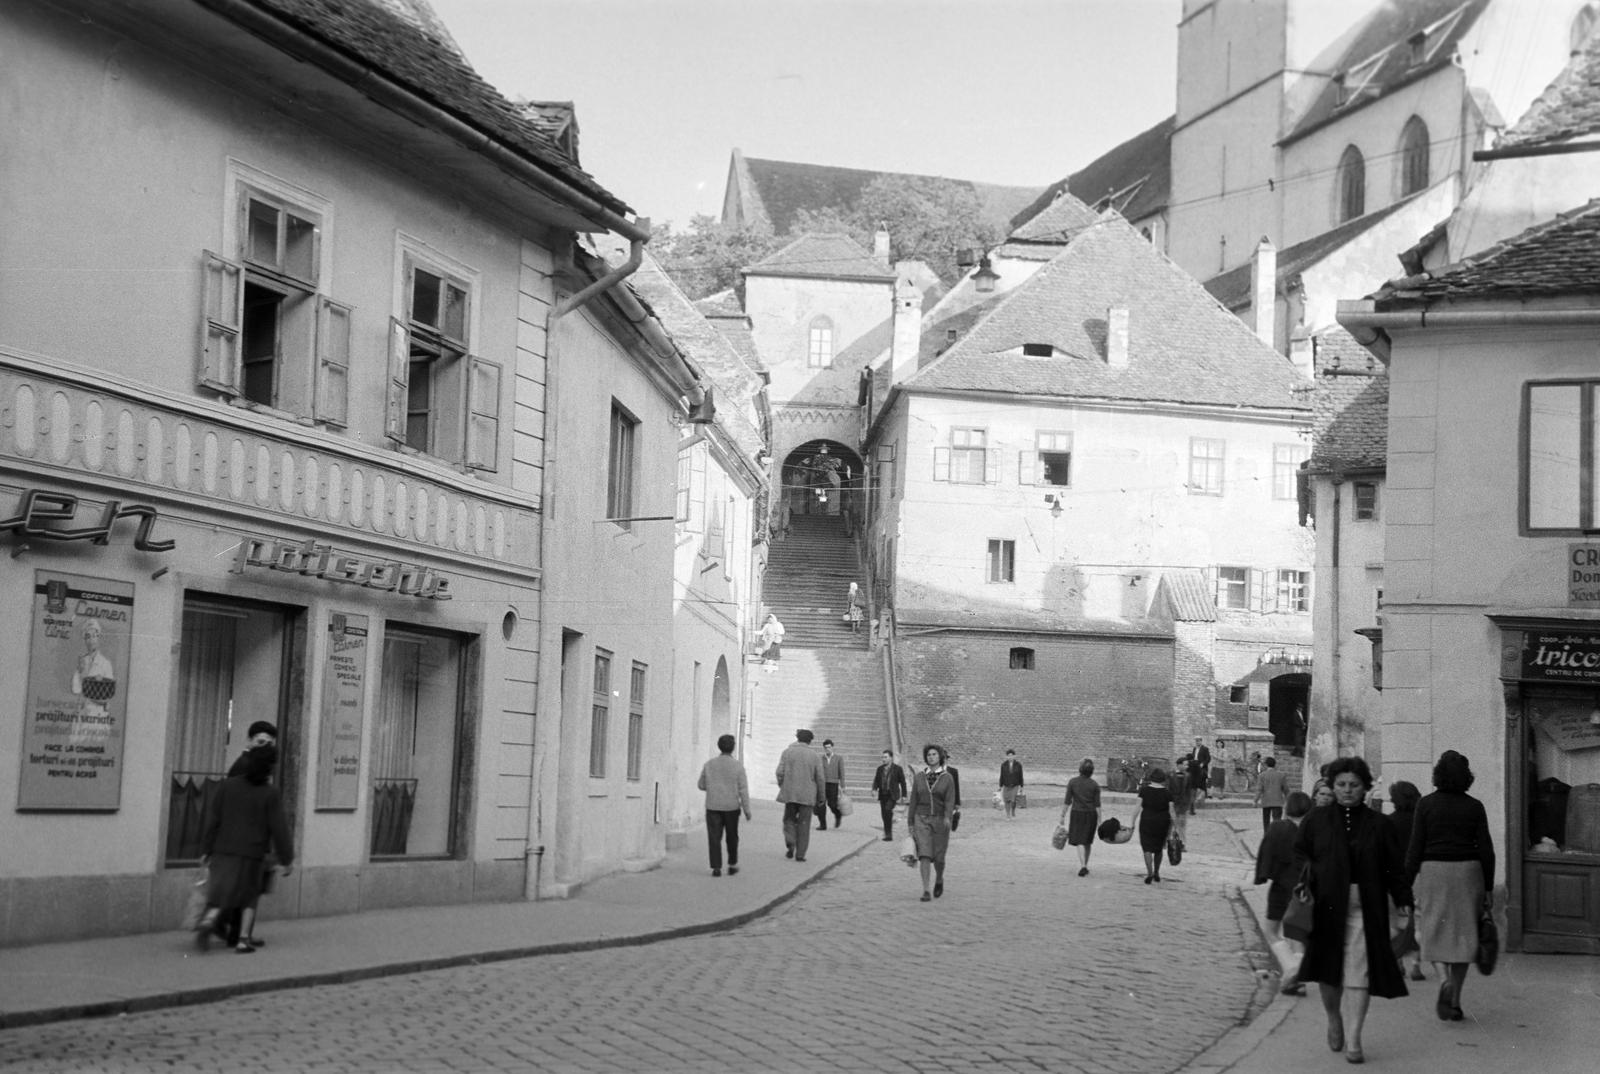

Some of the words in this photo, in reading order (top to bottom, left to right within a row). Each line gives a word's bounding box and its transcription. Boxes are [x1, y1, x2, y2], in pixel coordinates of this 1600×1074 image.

[0, 488, 175, 552] en
[228, 537, 452, 600] patiserie
[1572, 549, 1600, 566] CR
[1529, 644, 1600, 668] trico
[65, 744, 74, 753] LA
